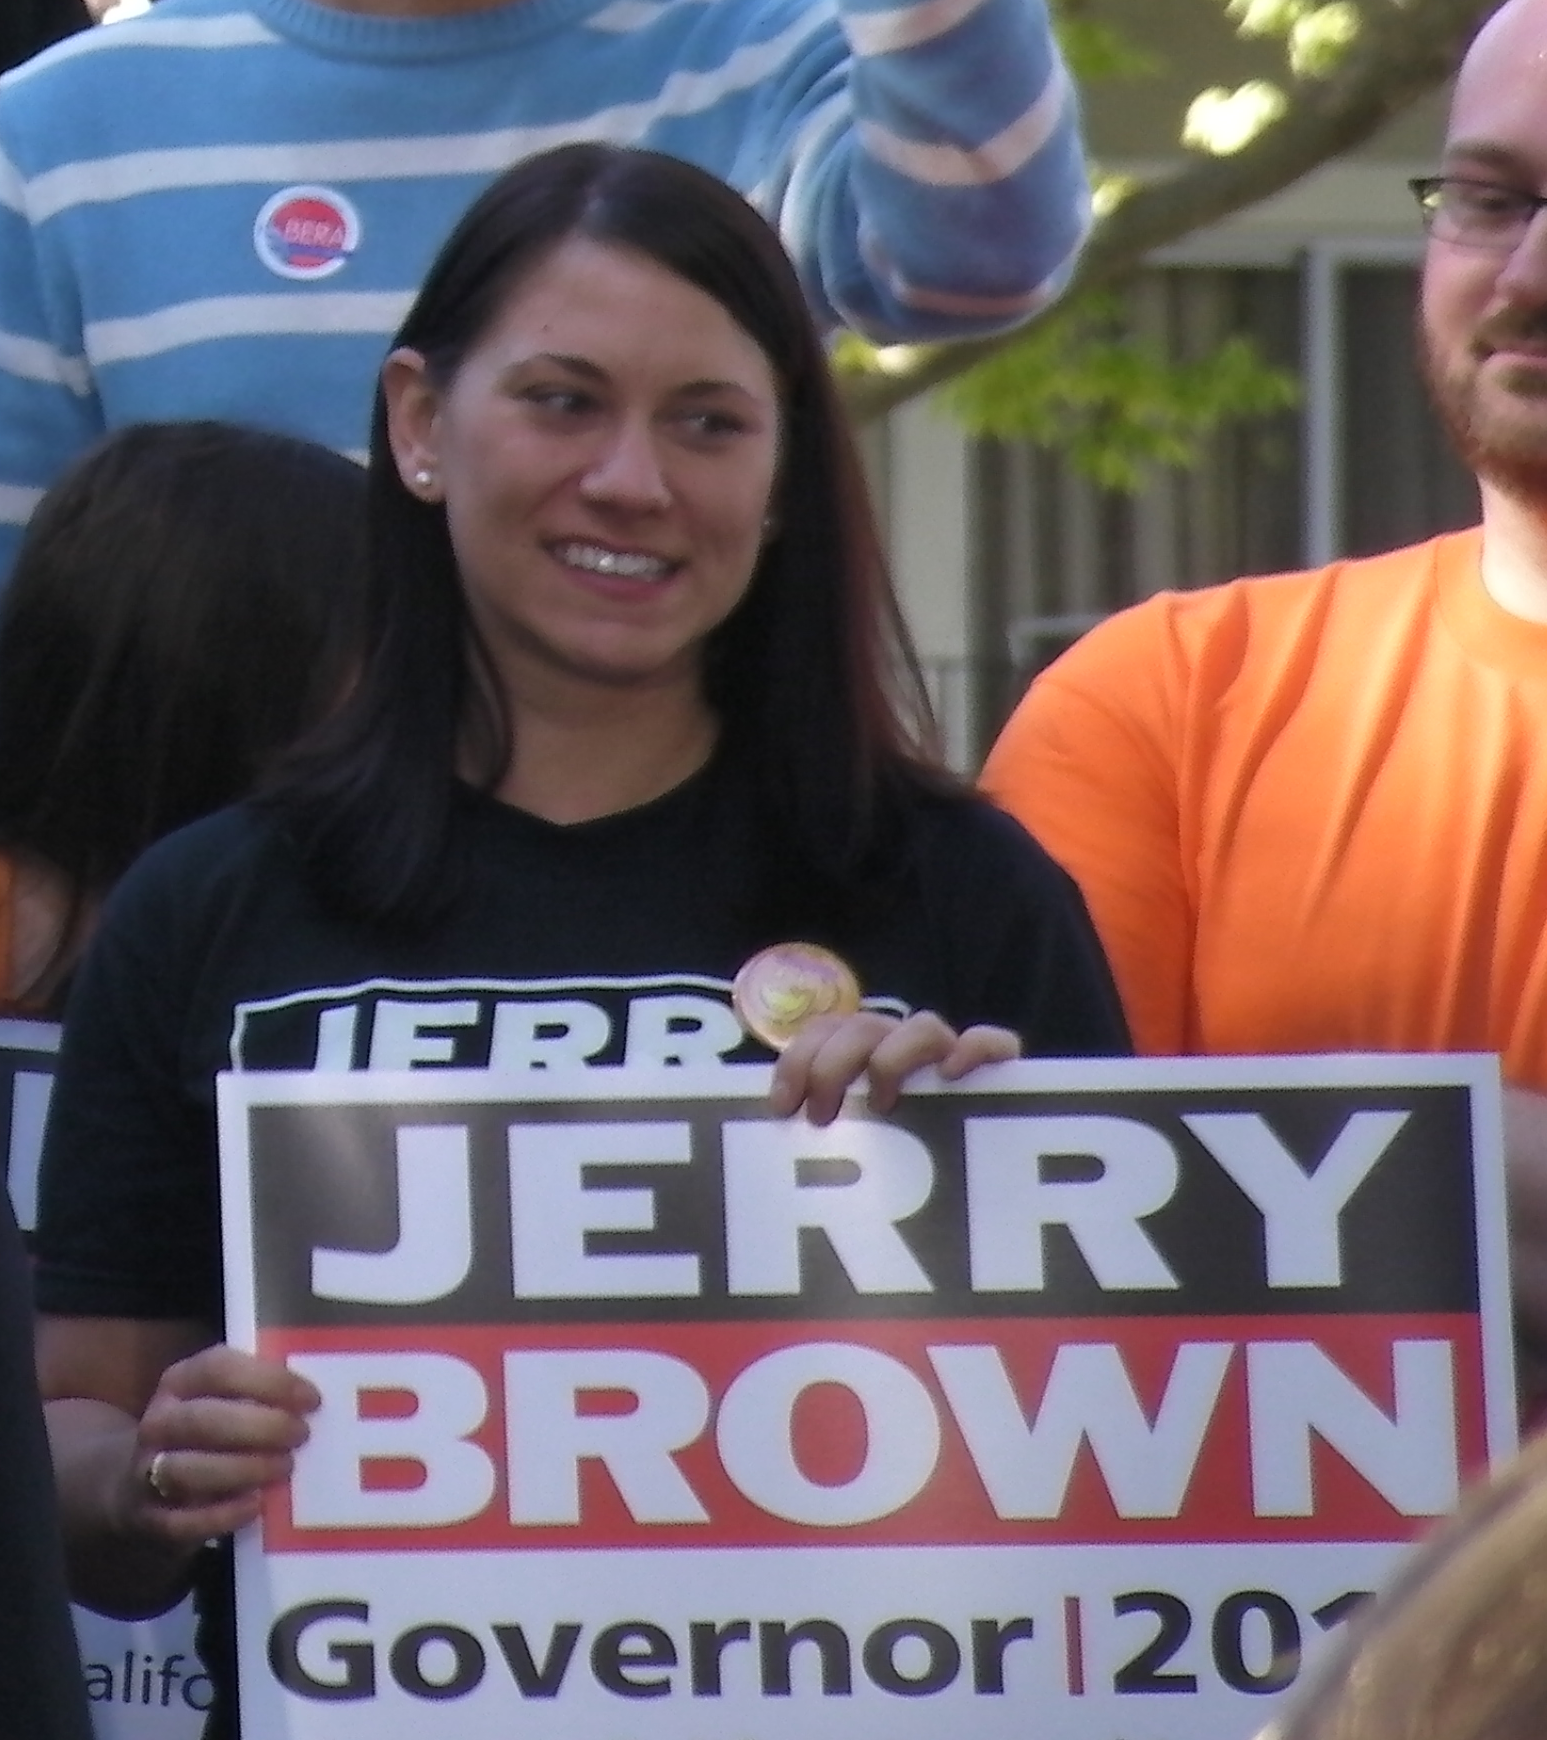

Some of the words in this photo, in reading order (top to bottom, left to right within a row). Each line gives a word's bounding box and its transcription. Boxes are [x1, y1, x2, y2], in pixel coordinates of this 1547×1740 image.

[309, 1109, 1410, 1306] JERRY
[285, 1339, 1458, 1532] BROWN
[267, 1596, 1035, 1704] Governor
